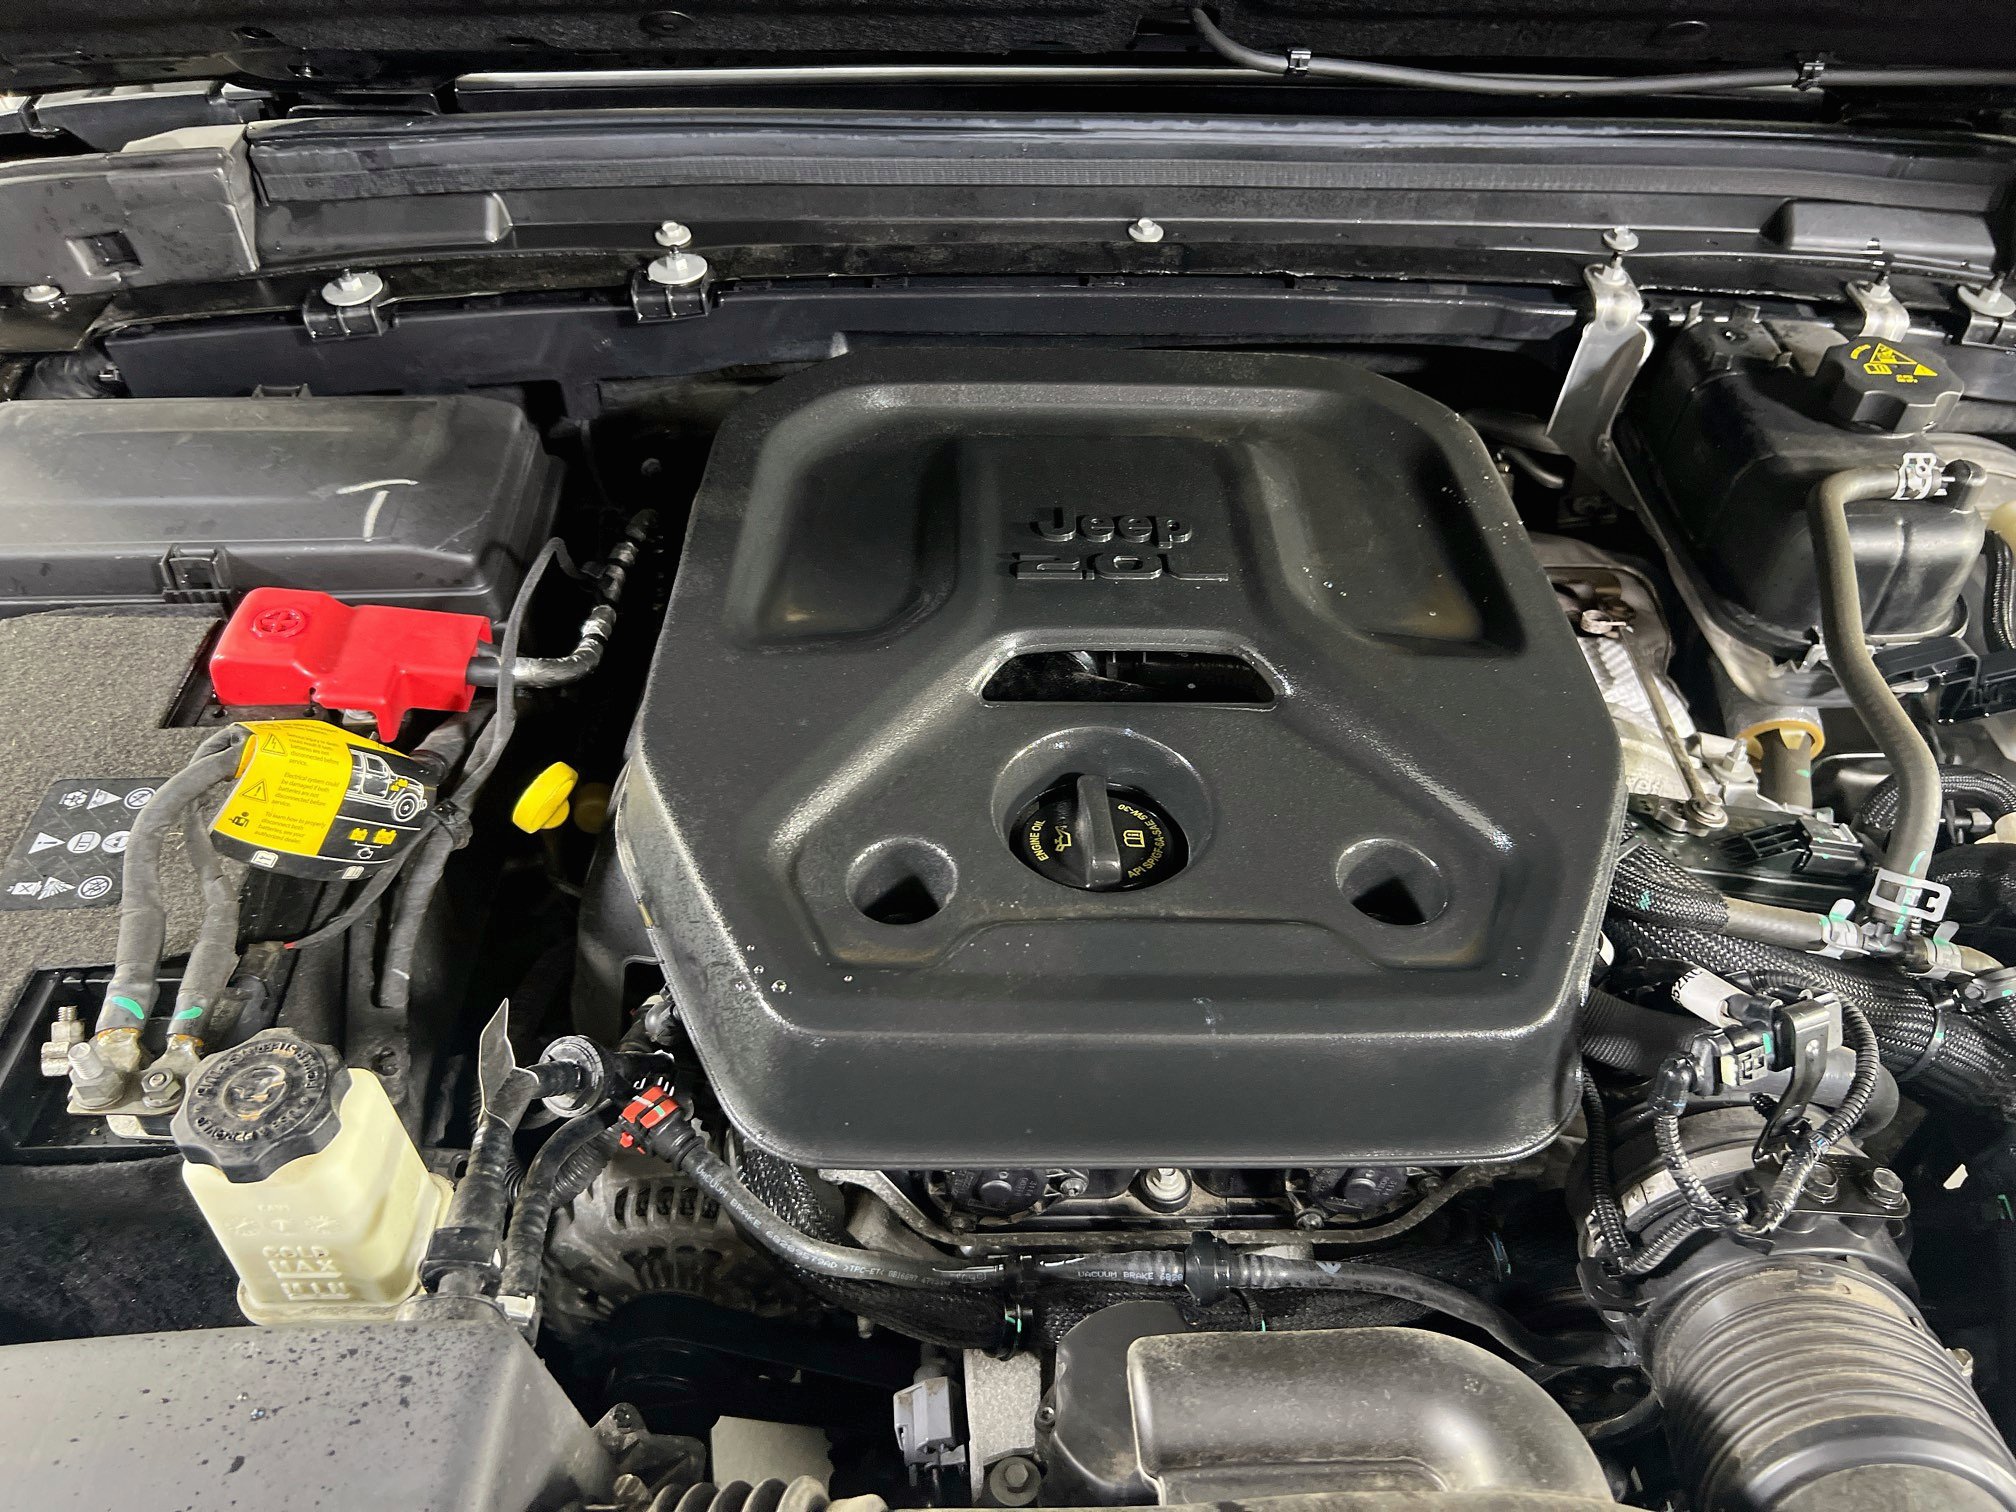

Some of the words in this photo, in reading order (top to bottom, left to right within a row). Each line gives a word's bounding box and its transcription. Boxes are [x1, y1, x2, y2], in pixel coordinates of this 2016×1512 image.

[1032, 506, 1193, 549] Jeep
[1010, 552, 1229, 581] 2.0L
[284, 772, 307, 781] Electrical
[278, 786, 301, 795] batteries
[1117, 803, 1148, 820] 5W-30
[1031, 820, 1046, 831] OIL
[1029, 832, 1050, 861] ENGINE
[1127, 866, 1147, 878] API
[195, 1116, 269, 1141] APPROVED
[696, 1163, 728, 1198] VACUUM
[729, 1197, 762, 1229] BRAKE
[262, 1245, 329, 1258] COLD
[268, 1259, 337, 1273] MAX
[1077, 1271, 1117, 1279] VACUUM
[1123, 1271, 1154, 1280] BRAKE
[281, 1282, 347, 1294] MIN
